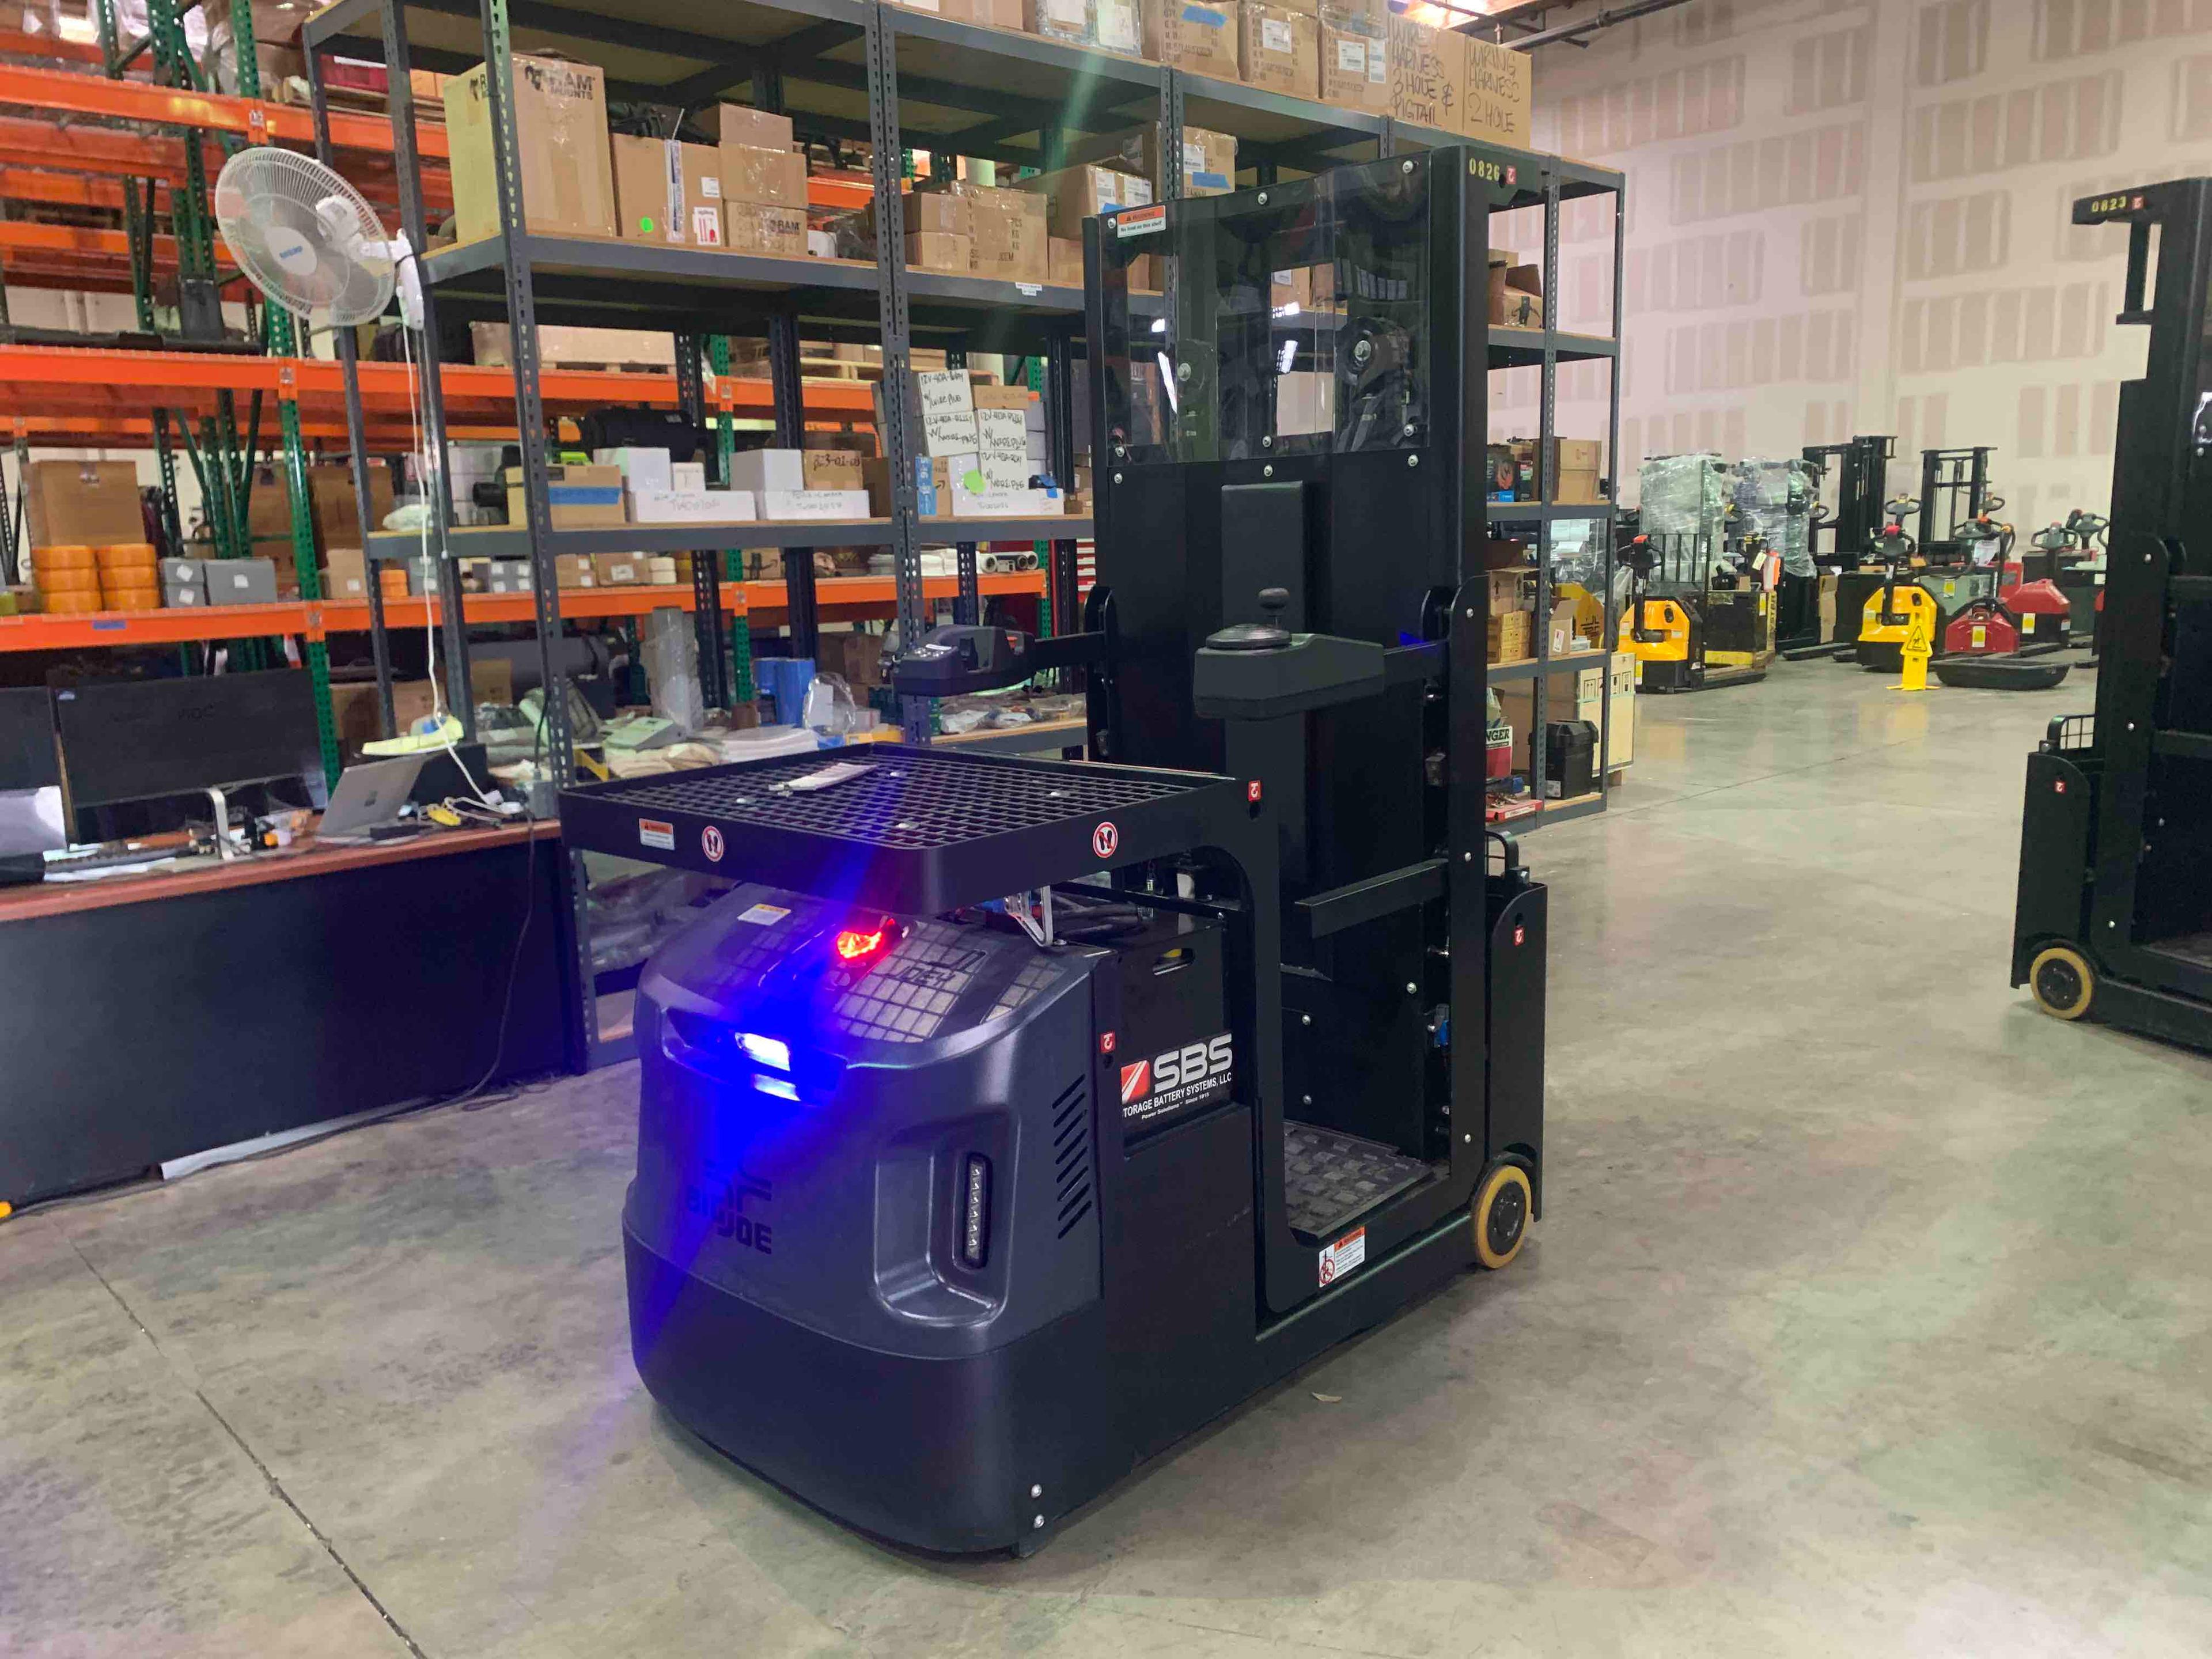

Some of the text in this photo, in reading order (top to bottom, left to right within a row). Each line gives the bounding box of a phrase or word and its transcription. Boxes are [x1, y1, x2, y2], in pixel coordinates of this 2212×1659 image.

[1392, 42, 1444, 79] HARNESS
[1469, 43, 1516, 78] WIRING
[1393, 68, 1403, 94] 3
[1406, 71, 1437, 100] HOLE
[1469, 66, 1520, 103] HARNESS
[1391, 92, 1441, 127] PIGTAIL
[1468, 92, 1515, 132] 2 HOLE
[1469, 157, 1500, 181] 0826
[2092, 196, 2126, 212] 0823
[1154, 1033, 1233, 1093] SBS
[1154, 1087, 1185, 1108] BATTERY
[1186, 1077, 1218, 1096] SYSTEMS,
[1219, 1072, 1232, 1084] LLC
[717, 1210, 772, 1256] JOE
